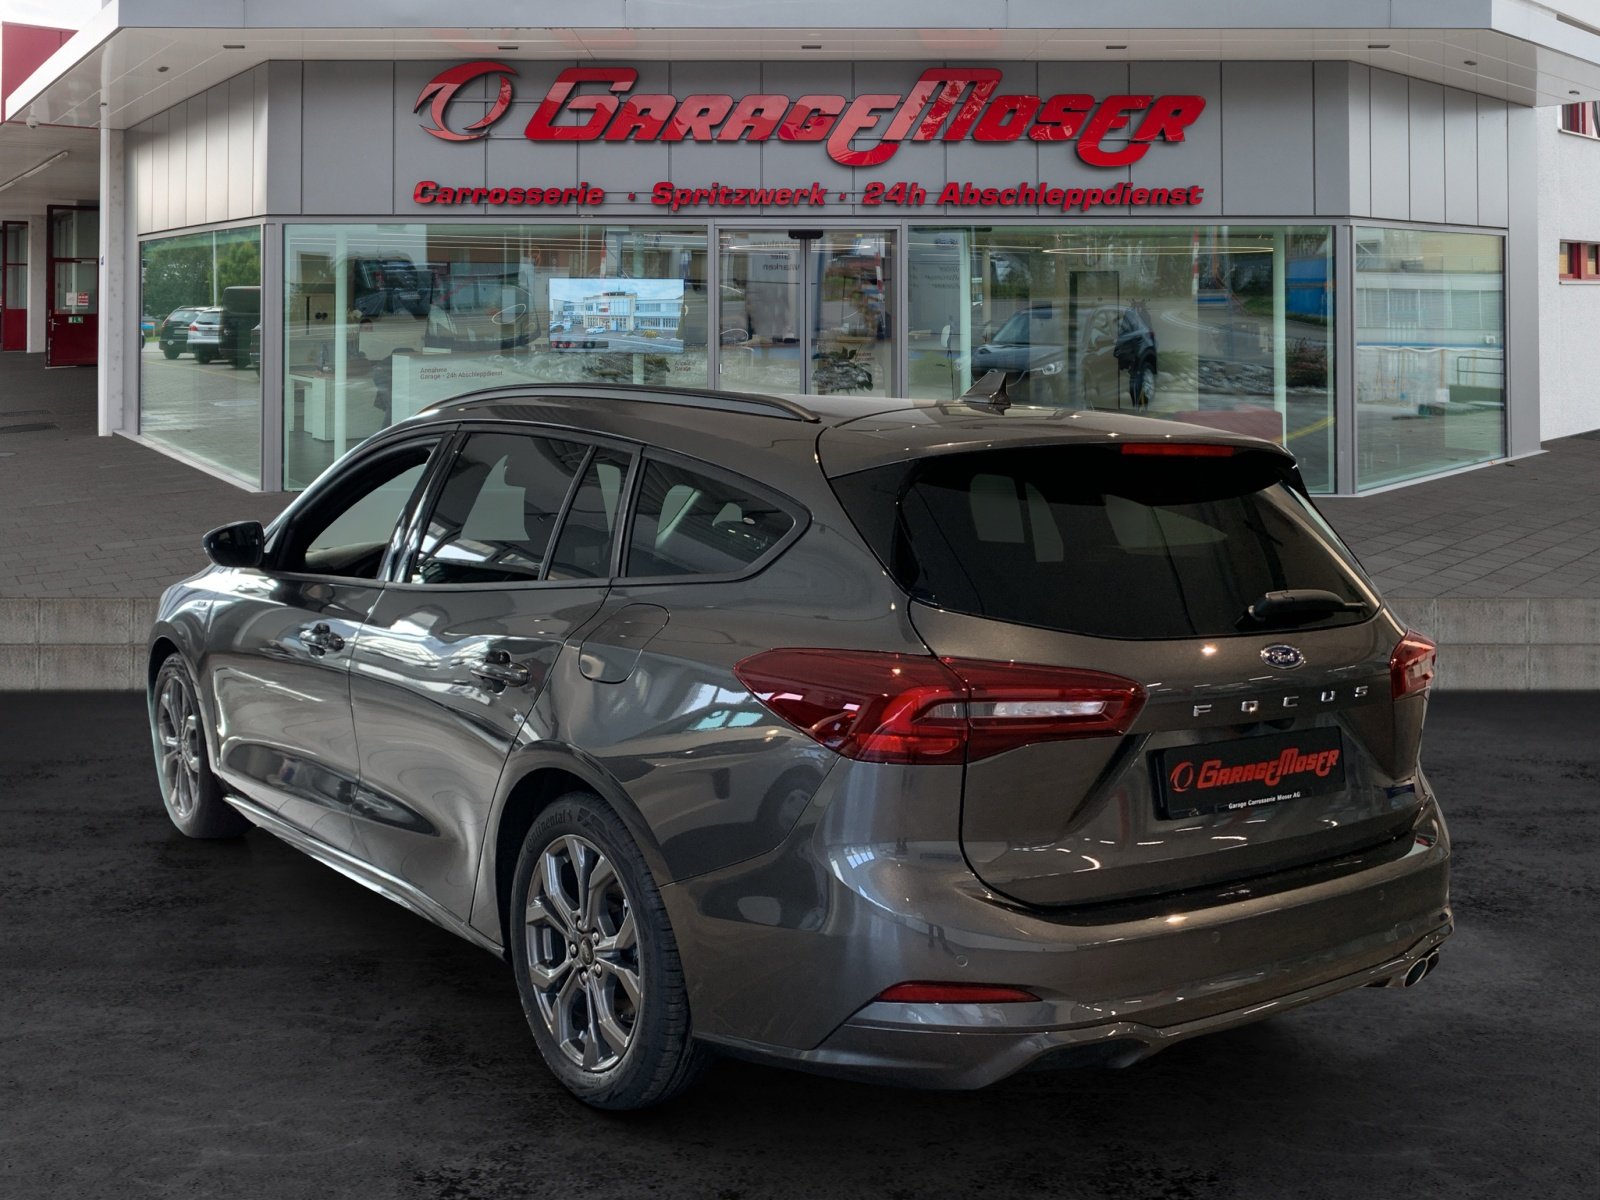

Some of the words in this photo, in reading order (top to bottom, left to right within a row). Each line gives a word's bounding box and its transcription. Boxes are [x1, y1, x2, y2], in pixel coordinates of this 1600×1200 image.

[413, 181, 604, 205] Carrosserie
[651, 181, 826, 210] Spritzwerk
[864, 182, 926, 206] 24h
[938, 182, 1203, 211] Abschleppdienst
[458, 370, 502, 379] Abschleppdienst
[1193, 685, 1368, 717] FOCUS
[1228, 802, 1247, 810] Garage
